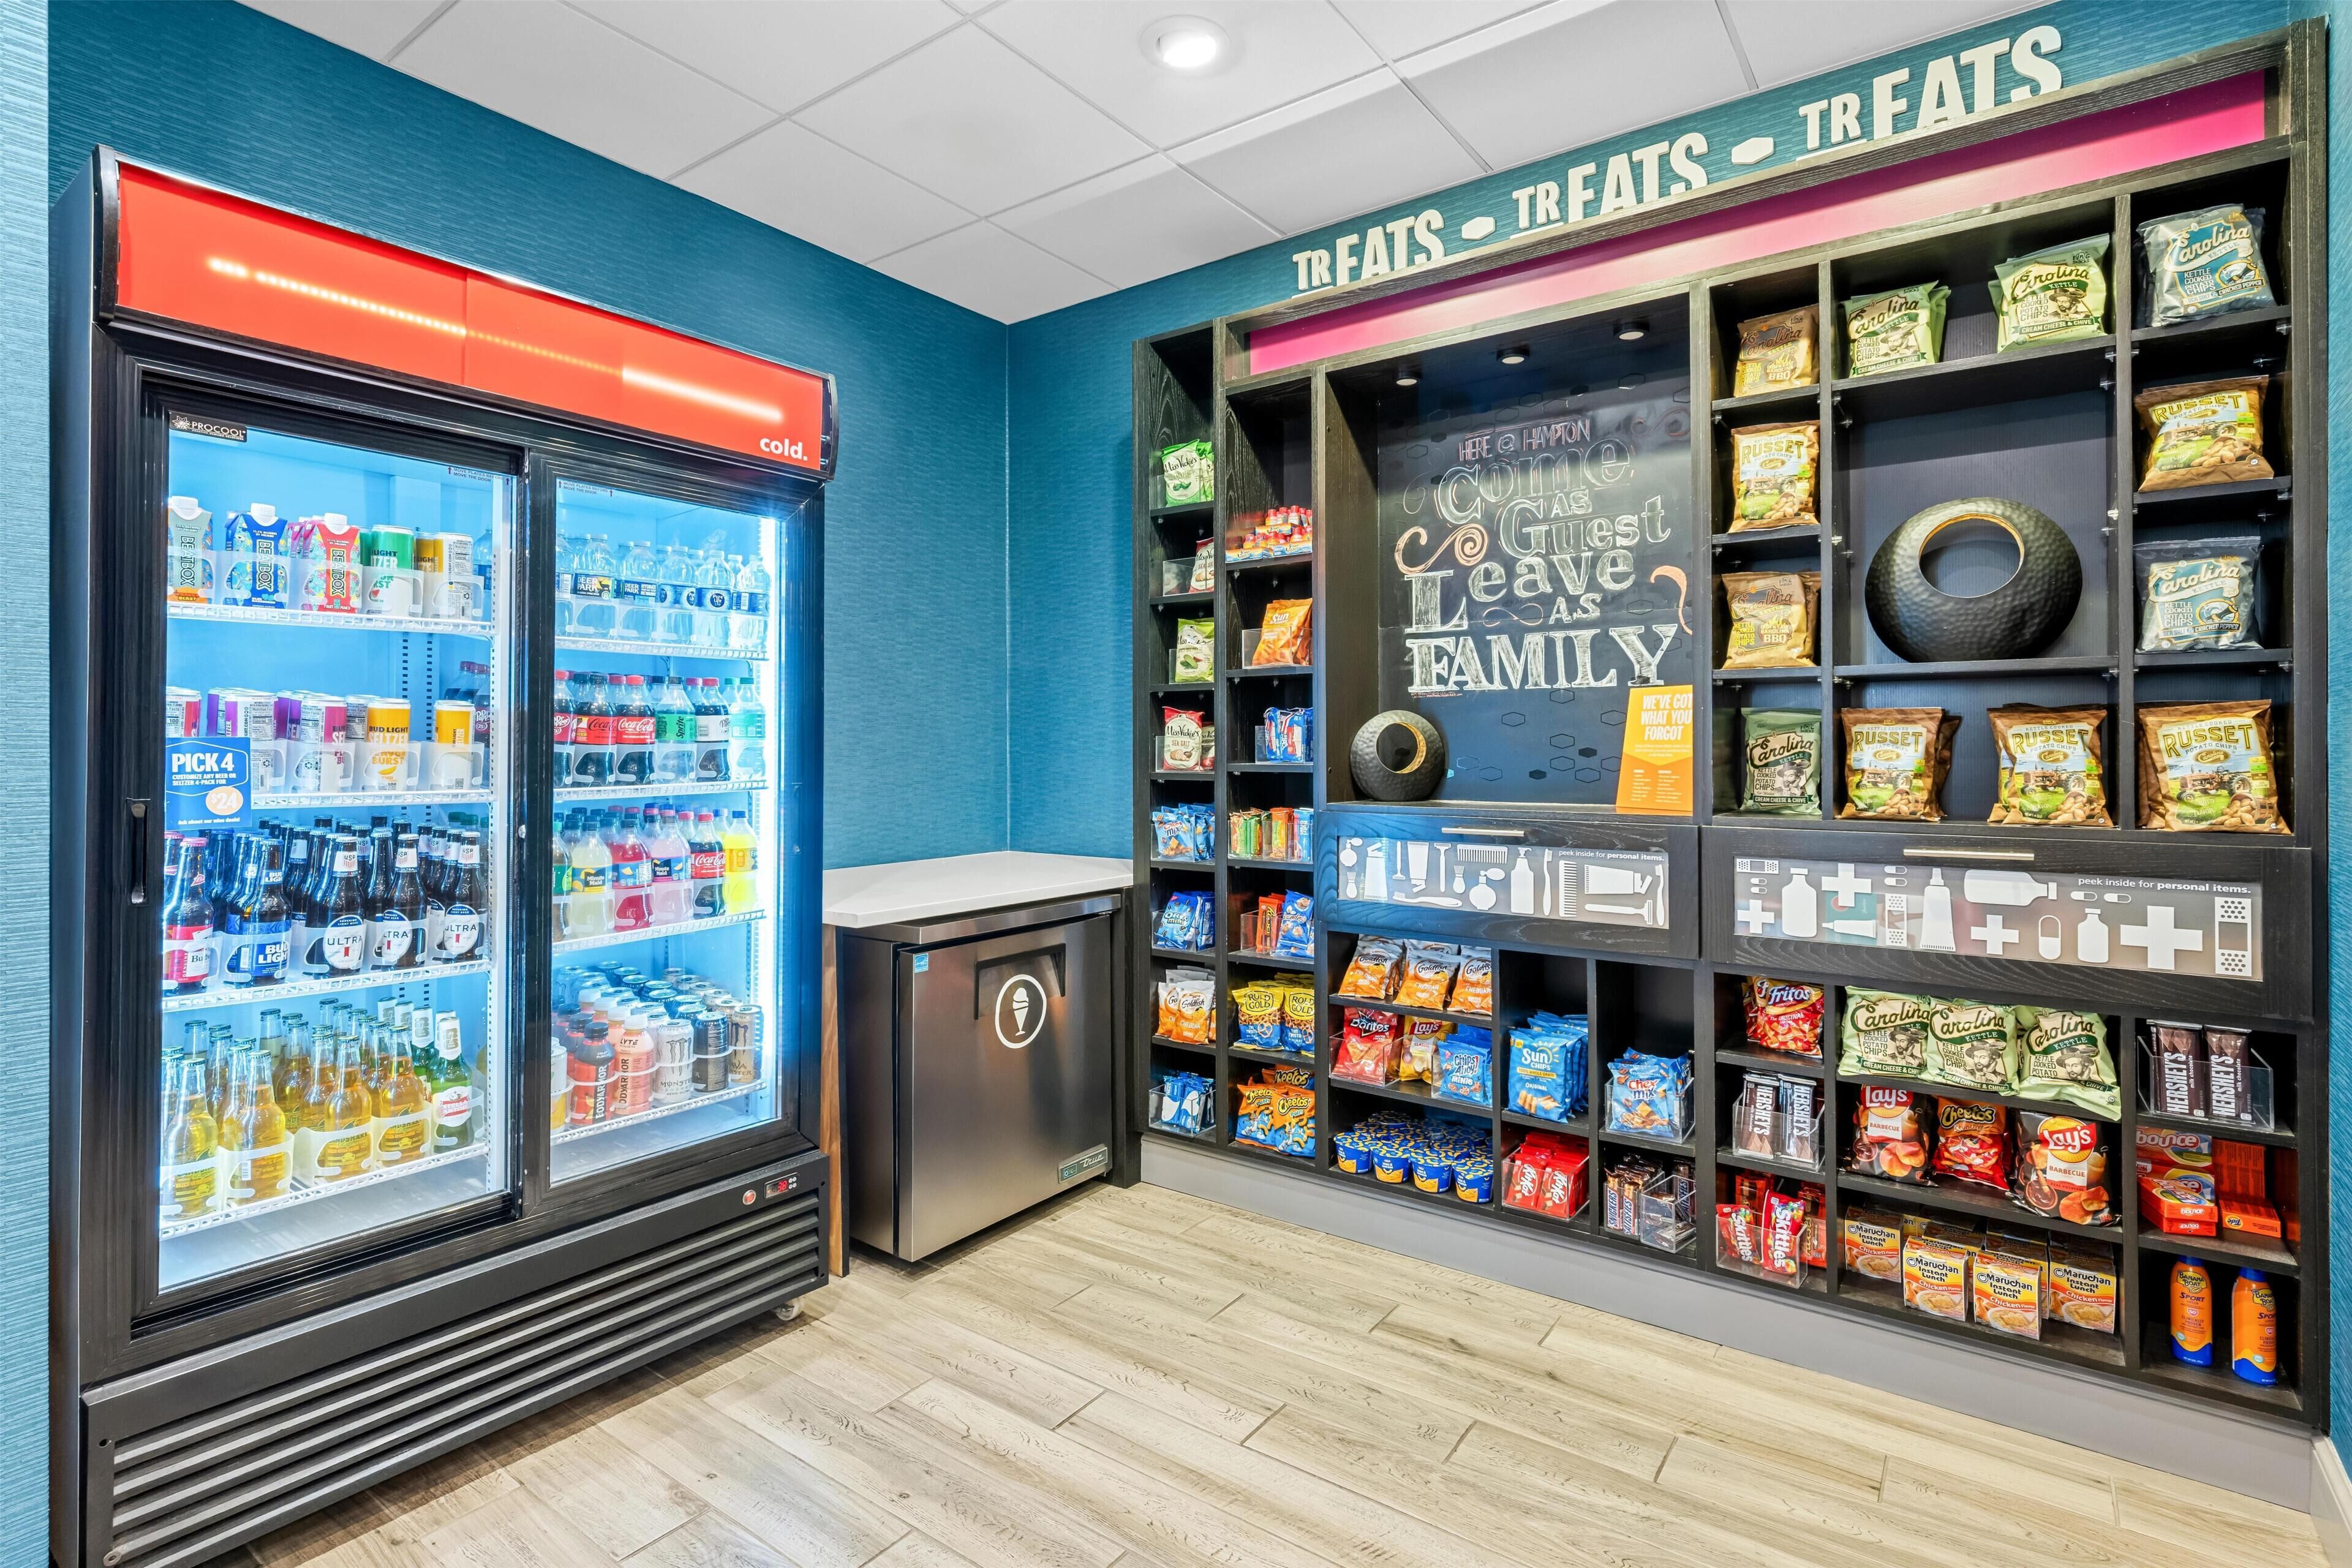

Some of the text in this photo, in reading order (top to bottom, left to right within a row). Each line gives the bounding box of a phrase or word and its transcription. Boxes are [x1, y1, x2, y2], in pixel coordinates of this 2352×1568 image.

[1800, 25, 2063, 151] TREATS
[1512, 132, 1709, 230] TREATS
[1292, 209, 1445, 290] TREATS
[2243, 279, 2262, 289] PEPPER
[2021, 300, 2048, 309] COOKED
[2021, 305, 2048, 315] POTATO
[2021, 311, 2048, 322] CHIPS
[1880, 315, 1909, 332] KETTLE
[2044, 322, 2067, 330] CHEESE
[1856, 352, 1880, 362] CHIPS
[1858, 364, 1877, 373] CREAM
[1877, 360, 1896, 369] CHEESE
[1902, 355, 1918, 364] CHIVE
[2154, 394, 2242, 423] RUSSET
[192, 421, 244, 437] PROCOOL
[1459, 436, 1491, 461] HERE
[1523, 419, 1591, 451] HAMPTON
[760, 437, 808, 461] cold.
[1742, 440, 1804, 464] RUSSET
[1178, 456, 1197, 469] Vickie's
[1438, 439, 1630, 524] Come
[1500, 495, 1672, 559] Guest
[180, 535, 195, 588] BEATBOX
[578, 576, 597, 585] DEER
[577, 583, 598, 592] PARK
[1404, 549, 1635, 633] Leave
[2195, 623, 2219, 633] CRACKED
[1763, 633, 1787, 643] BBQ
[1406, 624, 1678, 692] FAMILY
[1643, 693, 1692, 709] WE'VE GOT
[1641, 709, 1692, 725] WHAT YOU
[617, 717, 655, 732] Coca-Cola
[1166, 725, 1180, 736] Miss
[1644, 726, 1684, 741] FORGOT
[1853, 731, 1923, 752] RUSSET
[2012, 729, 2089, 755] RUSSET
[2163, 724, 2253, 758] RUSSET
[172, 753, 235, 773] PICK 4
[372, 756, 404, 765] BURST
[211, 792, 238, 809] $24
[1559, 848, 1574, 858] peek
[1607, 852, 1638, 862] personal
[2078, 876, 2252, 894] peek inside for personal items.
[327, 936, 362, 946] ULTRA
[1418, 963, 1447, 973] Goldfish
[1768, 986, 1811, 1005] Fritos
[1248, 1001, 1271, 1010] GOLD
[1778, 1012, 1804, 1022] ORIGINAL
[1851, 1002, 1930, 1032] Carolina
[1180, 1021, 1200, 1030] CHEDDAR
[1351, 1018, 1390, 1033] Doritos
[1414, 1022, 1439, 1035] Lay's
[2054, 1037, 2087, 1050] KETTLE
[1521, 1048, 1550, 1065] Sun
[1863, 1047, 1888, 1057] CHIPS
[1454, 1055, 1475, 1066] Chips
[1628, 1079, 1659, 1090] Chex
[2164, 1052, 2189, 1114] HERSHEY'S
[2211, 1055, 2236, 1117] HERSHEY'S
[1632, 1088, 1656, 1101] mix
[442, 1099, 468, 1110] STELLA
[1278, 1097, 1309, 1113] Cheetos
[1753, 1085, 1773, 1136] HERSHEY'S
[1291, 1109, 1304, 1118] Puffs
[1942, 1105, 1995, 1128] Cheetos
[1869, 1122, 1900, 1132] BARBECUE
[2043, 1125, 2092, 1153] Lay's
[2136, 1131, 2197, 1148] bounce
[1080, 1155, 1105, 1167] true
[2049, 1166, 2086, 1177] BARBECUE
[777, 1180, 788, 1192] 38
[1607, 1189, 1618, 1227] SNICKERS
[1773, 1208, 1791, 1268] Skittles
[1916, 1257, 1959, 1274] Maruchan
[1918, 1266, 1948, 1278] Instant
[1922, 1272, 1945, 1283] Lunch
[1986, 1273, 2032, 1291] Maruchan
[2064, 1268, 2111, 1286] Maruchan
[2177, 1270, 2205, 1282] BANANA
[1918, 1280, 1948, 1291] Chicken
[1989, 1282, 2021, 1295] Instant
[2067, 1277, 2099, 1289] Instant
[2070, 1283, 2095, 1294] Lunch
[2182, 1279, 2201, 1287] BOAT
[1993, 1289, 2018, 1300] Lunch
[2066, 1291, 2098, 1303] Chicken
[2180, 1292, 2205, 1302] SPORT
[1990, 1297, 2021, 1308] Chicken
